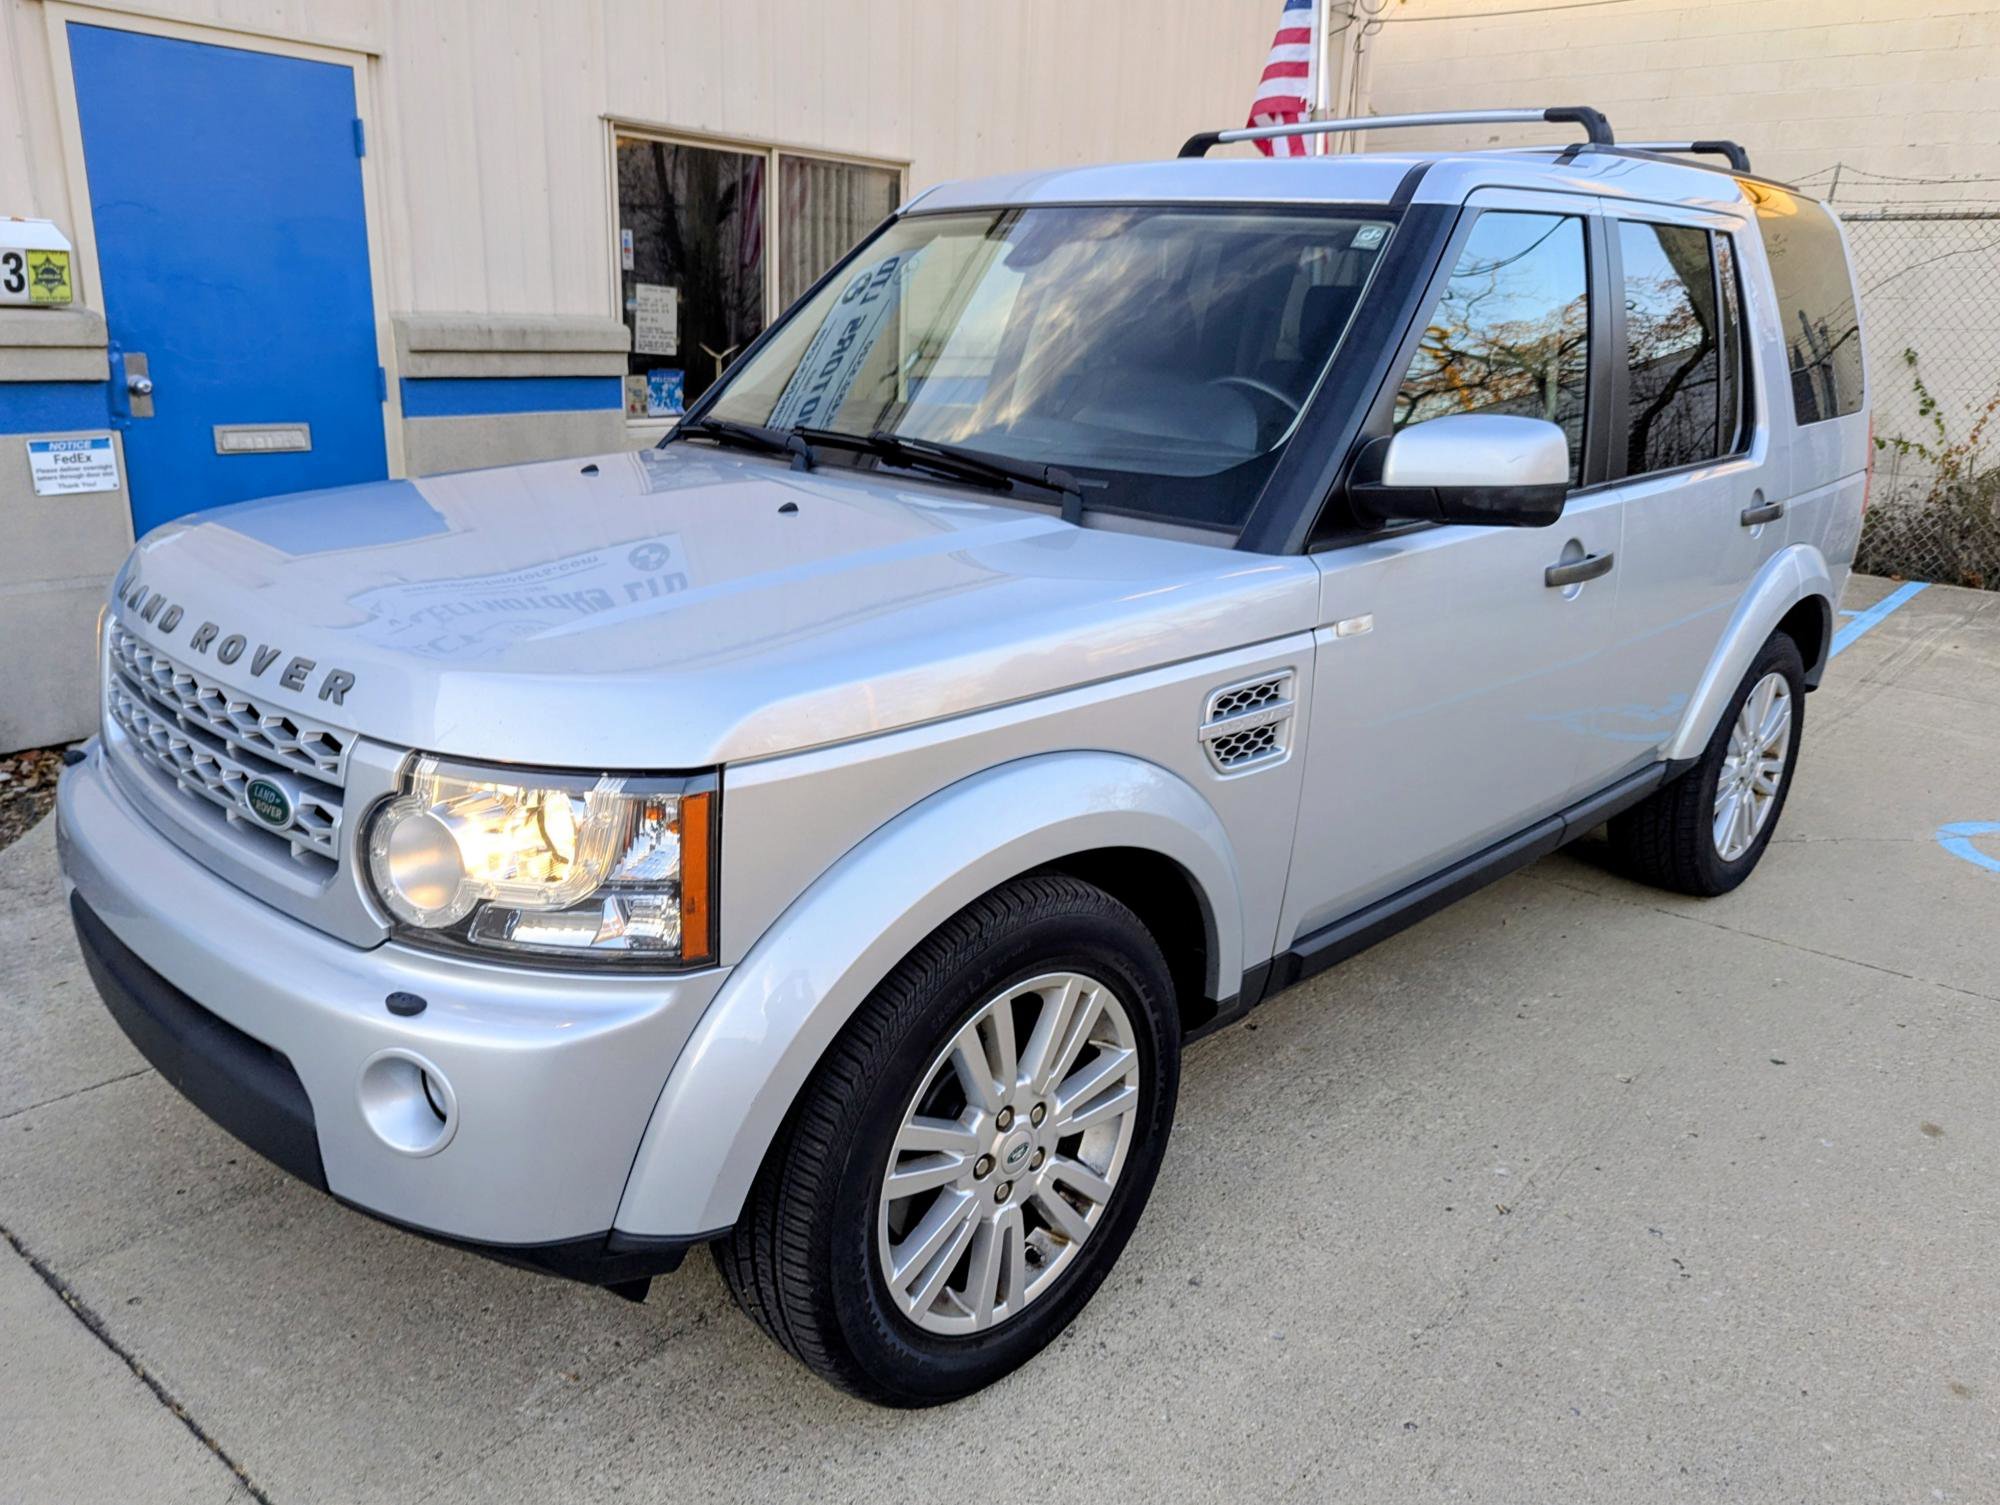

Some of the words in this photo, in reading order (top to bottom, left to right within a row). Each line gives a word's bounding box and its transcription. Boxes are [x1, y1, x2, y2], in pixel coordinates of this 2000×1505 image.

[2, 252, 26, 294] 3
[48, 439, 92, 452] NOTICE
[53, 453, 92, 465] FedEx
[118, 575, 184, 634] LAND
[190, 621, 356, 706] ROVER
[254, 785, 276, 804] LAND
[255, 799, 283, 820] ROVER
